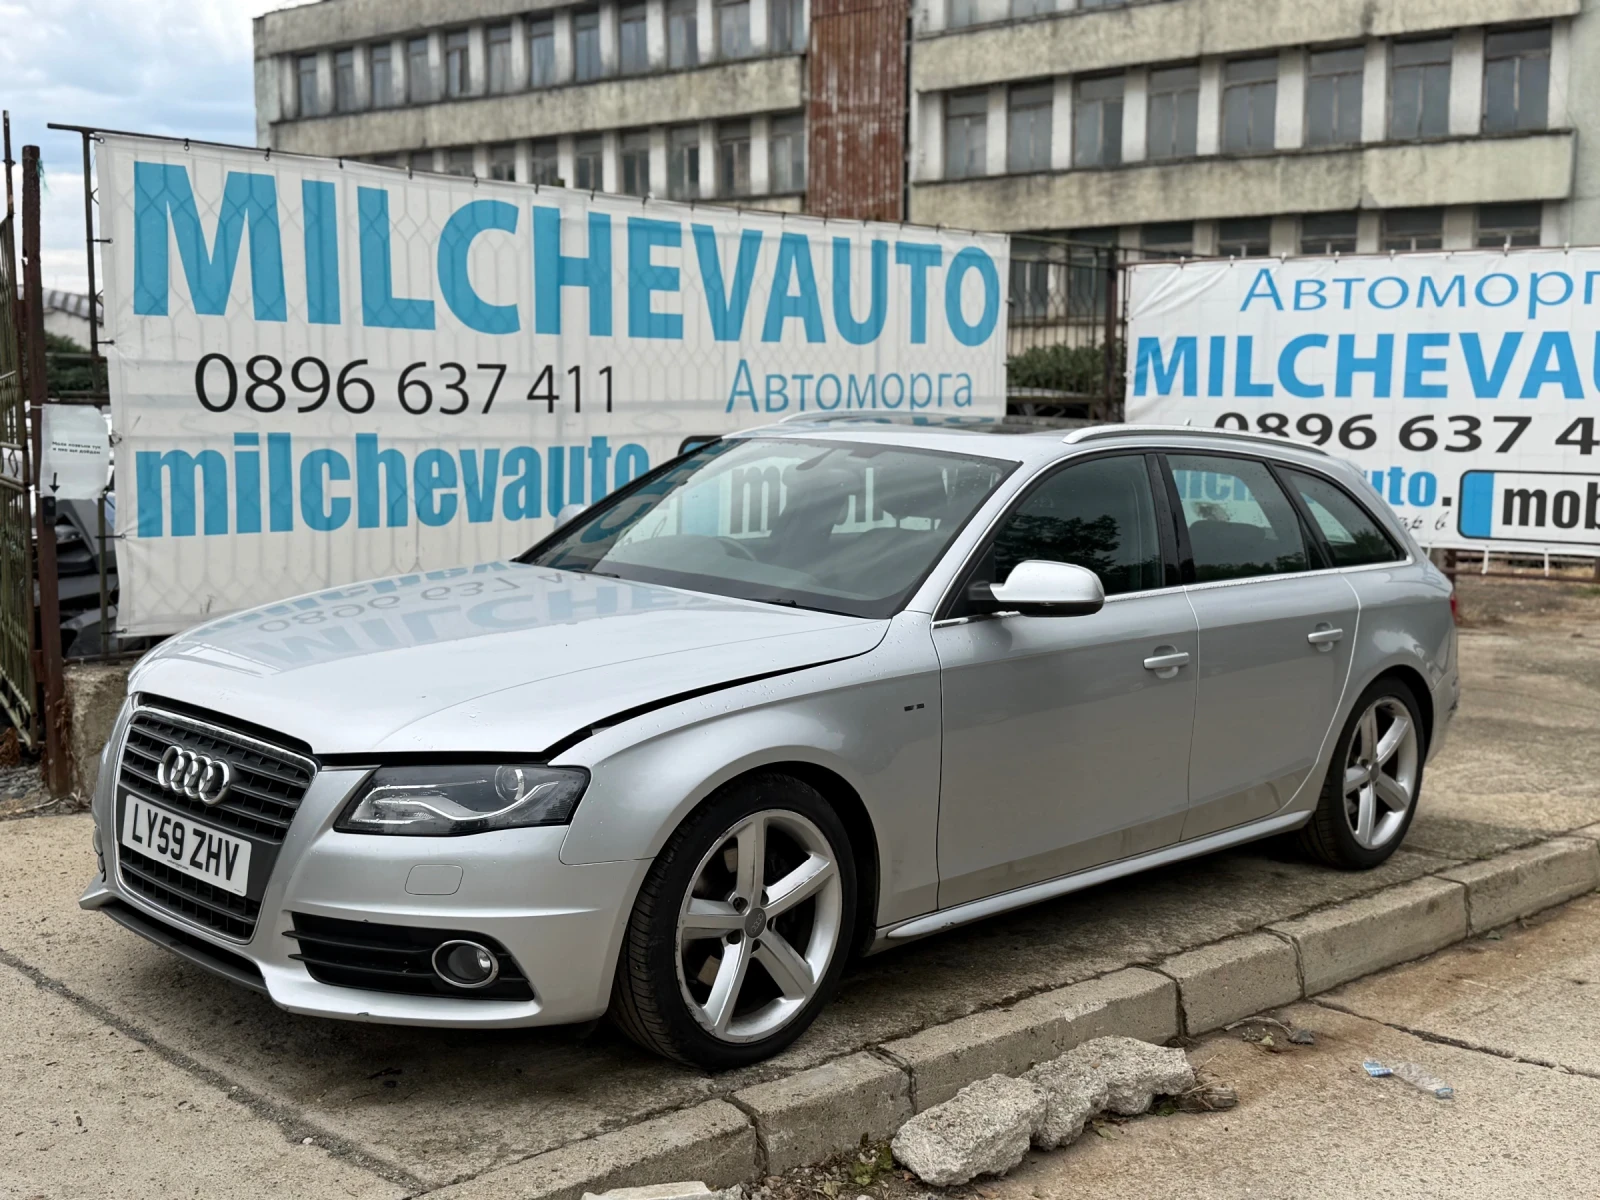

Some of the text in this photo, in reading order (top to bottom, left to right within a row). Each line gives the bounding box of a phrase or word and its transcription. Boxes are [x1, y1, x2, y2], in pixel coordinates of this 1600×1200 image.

[133, 161, 1000, 347] MILCHEVAUTO
[195, 353, 614, 415] 0896 637 411
[725, 358, 973, 414] Автоморга
[1399, 415, 1532, 453] 637
[1555, 416, 1600, 456] 4
[131, 803, 240, 882] LY59 ZHV
